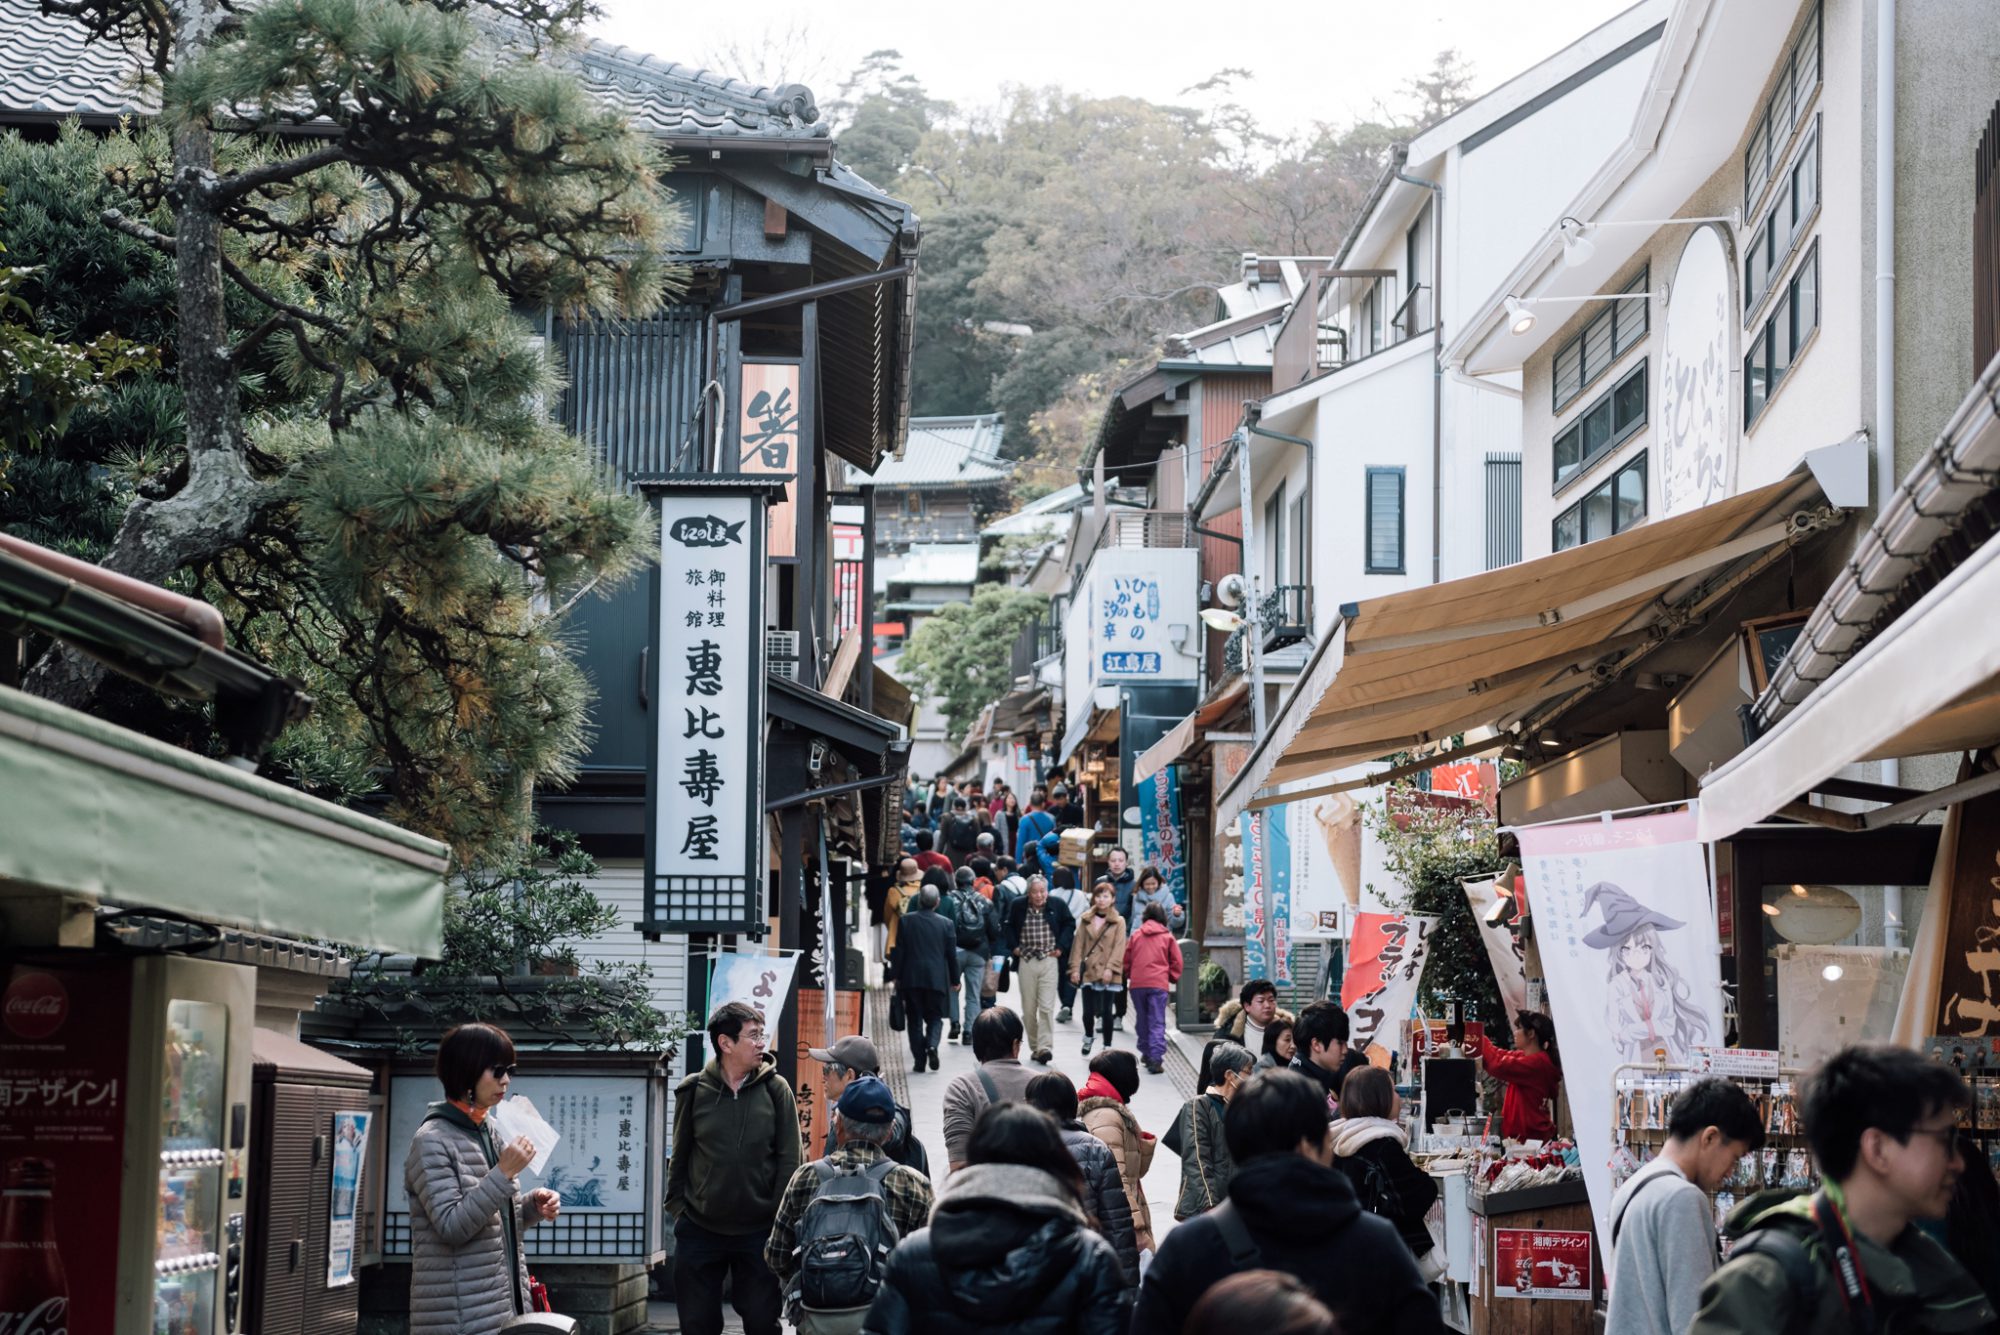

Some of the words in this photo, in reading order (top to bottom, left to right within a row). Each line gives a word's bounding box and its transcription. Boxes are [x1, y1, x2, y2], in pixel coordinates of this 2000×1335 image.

[685, 569, 704, 627] 旅館
[707, 569, 726, 627] 御料理
[1130, 578, 1147, 641] ひもの
[1106, 653, 1157, 672] 江島屋
[1403, 920, 1427, 981] しらす
[6, 996, 62, 1014] Coca-Cola
[1532, 1236, 1588, 1248] 湘南デザイン!
